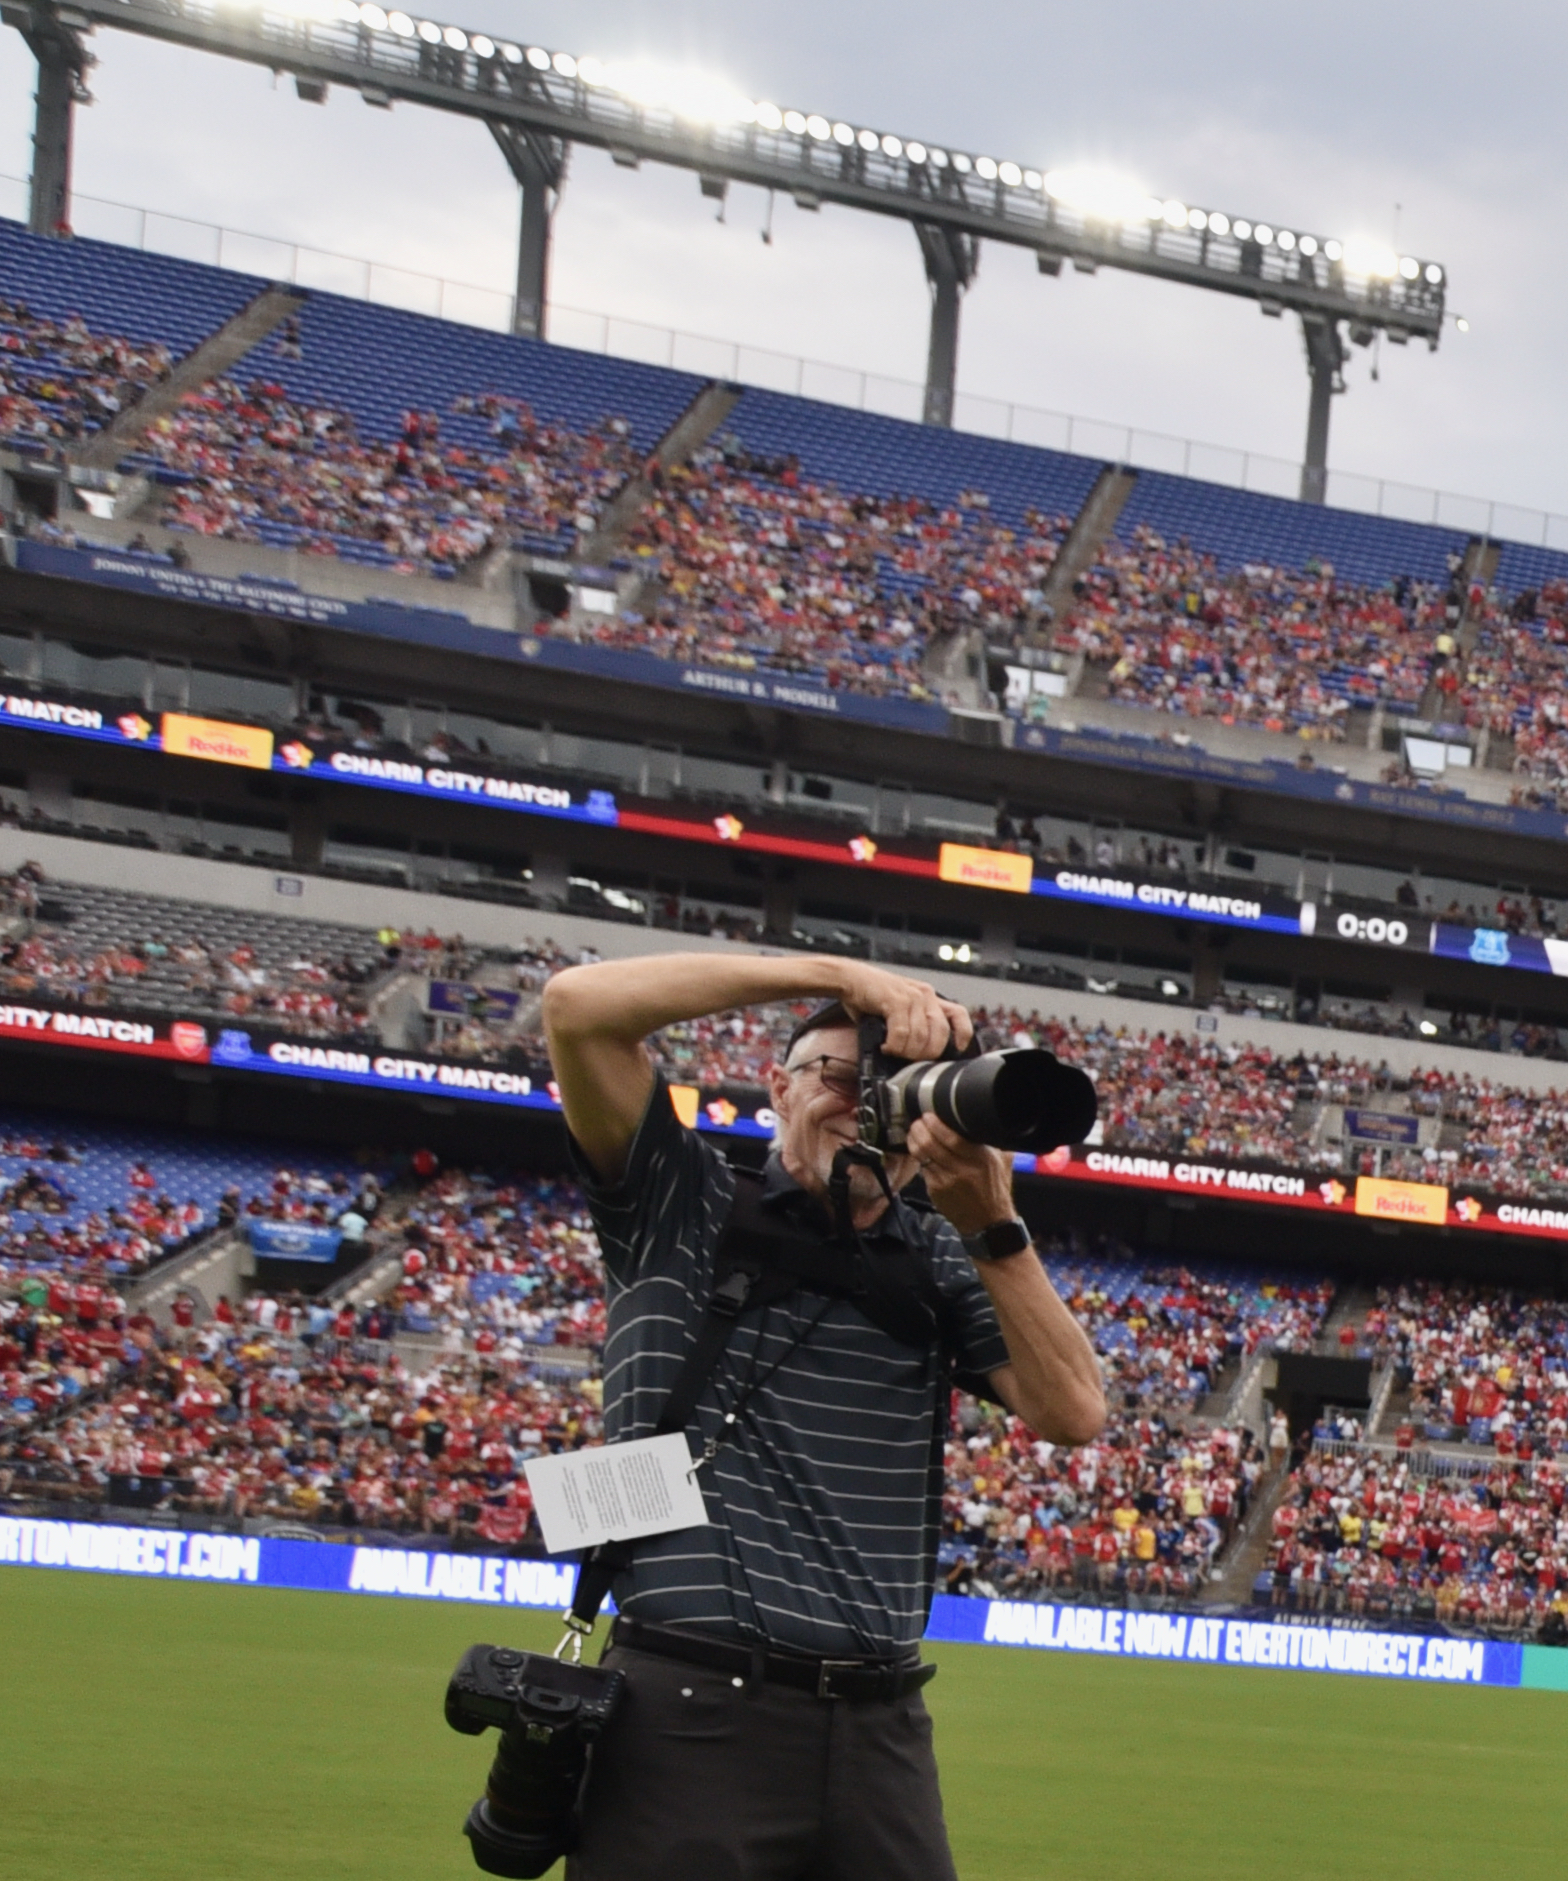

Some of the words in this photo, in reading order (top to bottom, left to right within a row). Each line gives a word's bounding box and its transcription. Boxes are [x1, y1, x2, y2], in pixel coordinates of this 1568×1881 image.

[6, 695, 103, 730] MATCH
[331, 752, 424, 784] CHARM
[425, 767, 485, 793] CITY
[483, 777, 570, 809] MATCH
[1055, 871, 1135, 899] CHARM
[1136, 884, 1187, 908] CITY
[1186, 892, 1261, 920] MATCH
[1337, 913, 1409, 945] 0:00
[52, 1011, 155, 1045] MATCH
[269, 1042, 371, 1075] CHARM
[373, 1056, 438, 1083] CITY
[436, 1064, 532, 1096] MATCH
[1084, 1151, 1171, 1181] CHARM
[1173, 1162, 1226, 1188] CITY
[1225, 1170, 1305, 1196] MATCH
[0, 1515, 261, 1582] RTONDIRECT.COM
[348, 1546, 503, 1602] AVAILABLE
[503, 1558, 576, 1607] NOW
[983, 1600, 1122, 1655] AVAILABLE
[1123, 1611, 1187, 1659] NOW
[1186, 1616, 1225, 1661] AT
[1223, 1619, 1485, 1682] EVERTONDIRECT.COM
